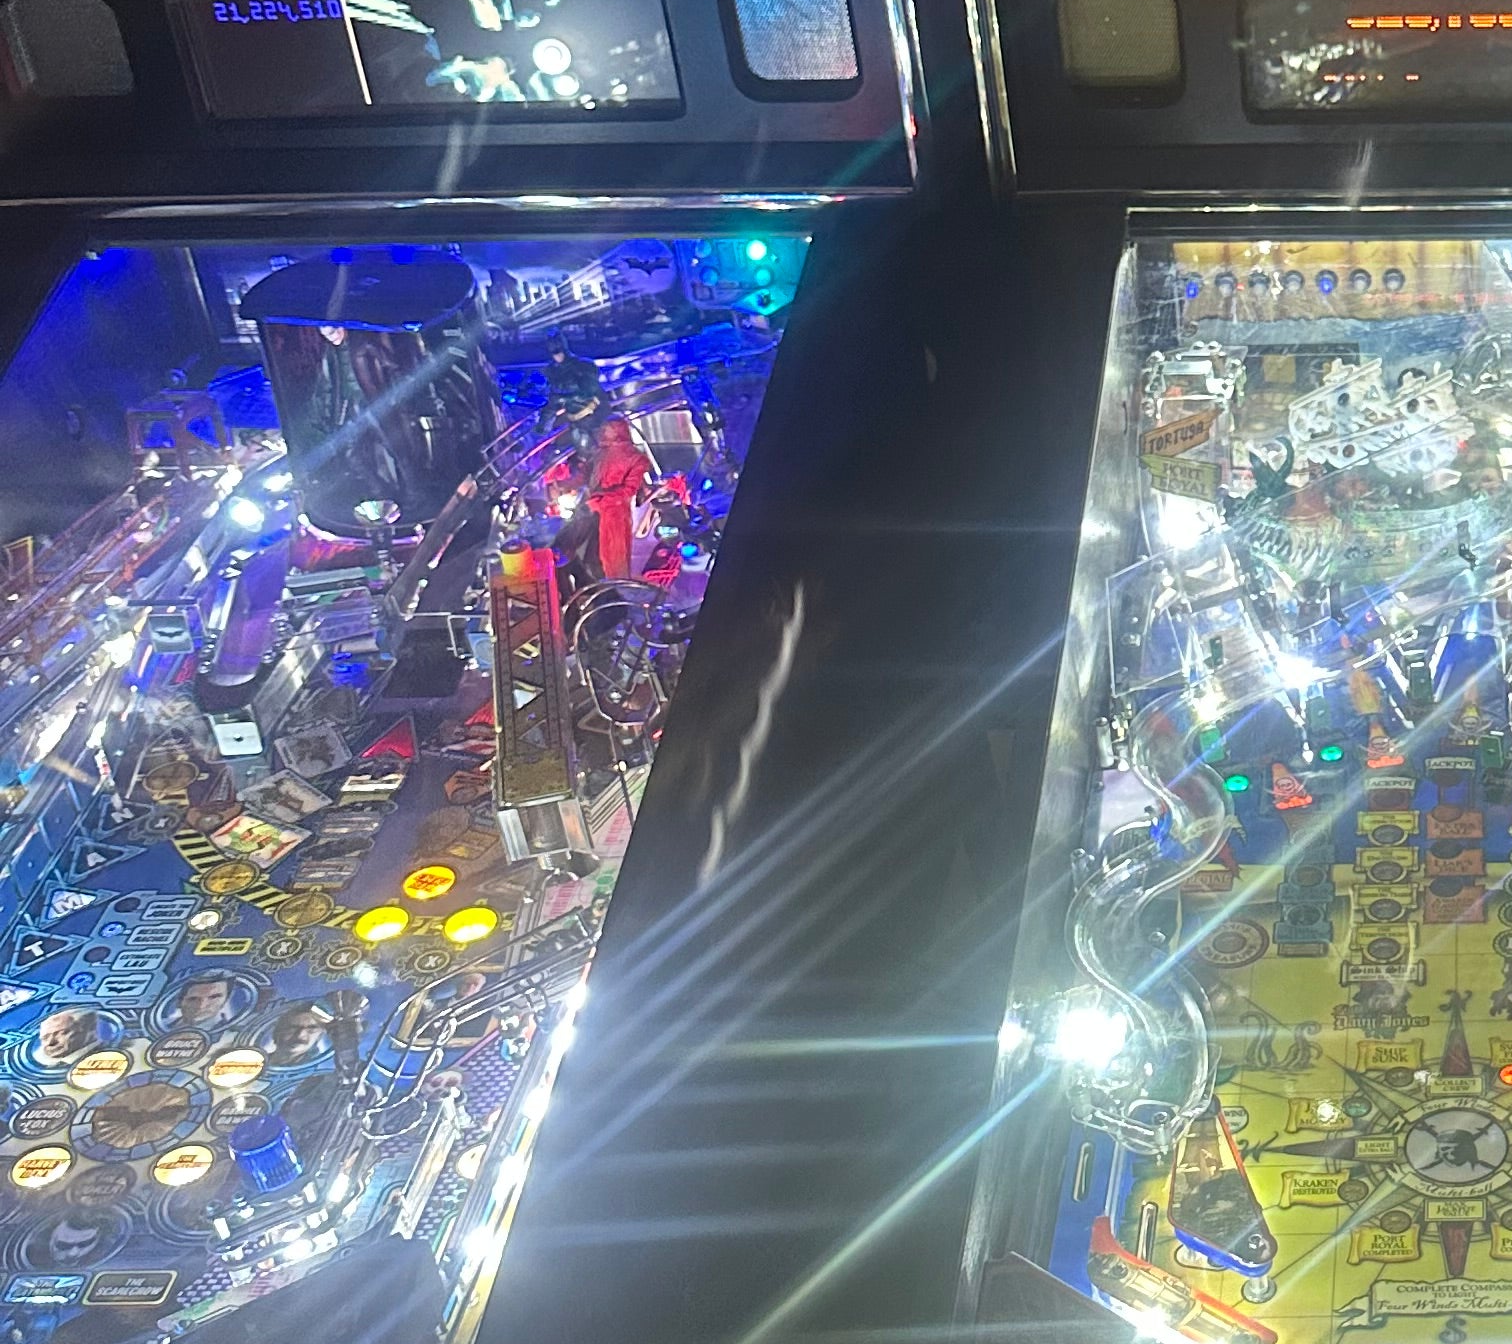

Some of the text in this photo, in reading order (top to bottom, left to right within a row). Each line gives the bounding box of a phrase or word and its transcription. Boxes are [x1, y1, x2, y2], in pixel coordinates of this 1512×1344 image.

[1374, 1047, 1408, 1055] SHIP
[1372, 1055, 1409, 1064] SUNK
[21, 1109, 67, 1119] LUCIUS
[1294, 1179, 1339, 1188] KRAKEN
[1373, 1234, 1405, 1243] PORT
[126, 1278, 146, 1286] THE
[96, 1286, 165, 1296] SCARECROW
[1396, 1284, 1458, 1293] COMPLETE
